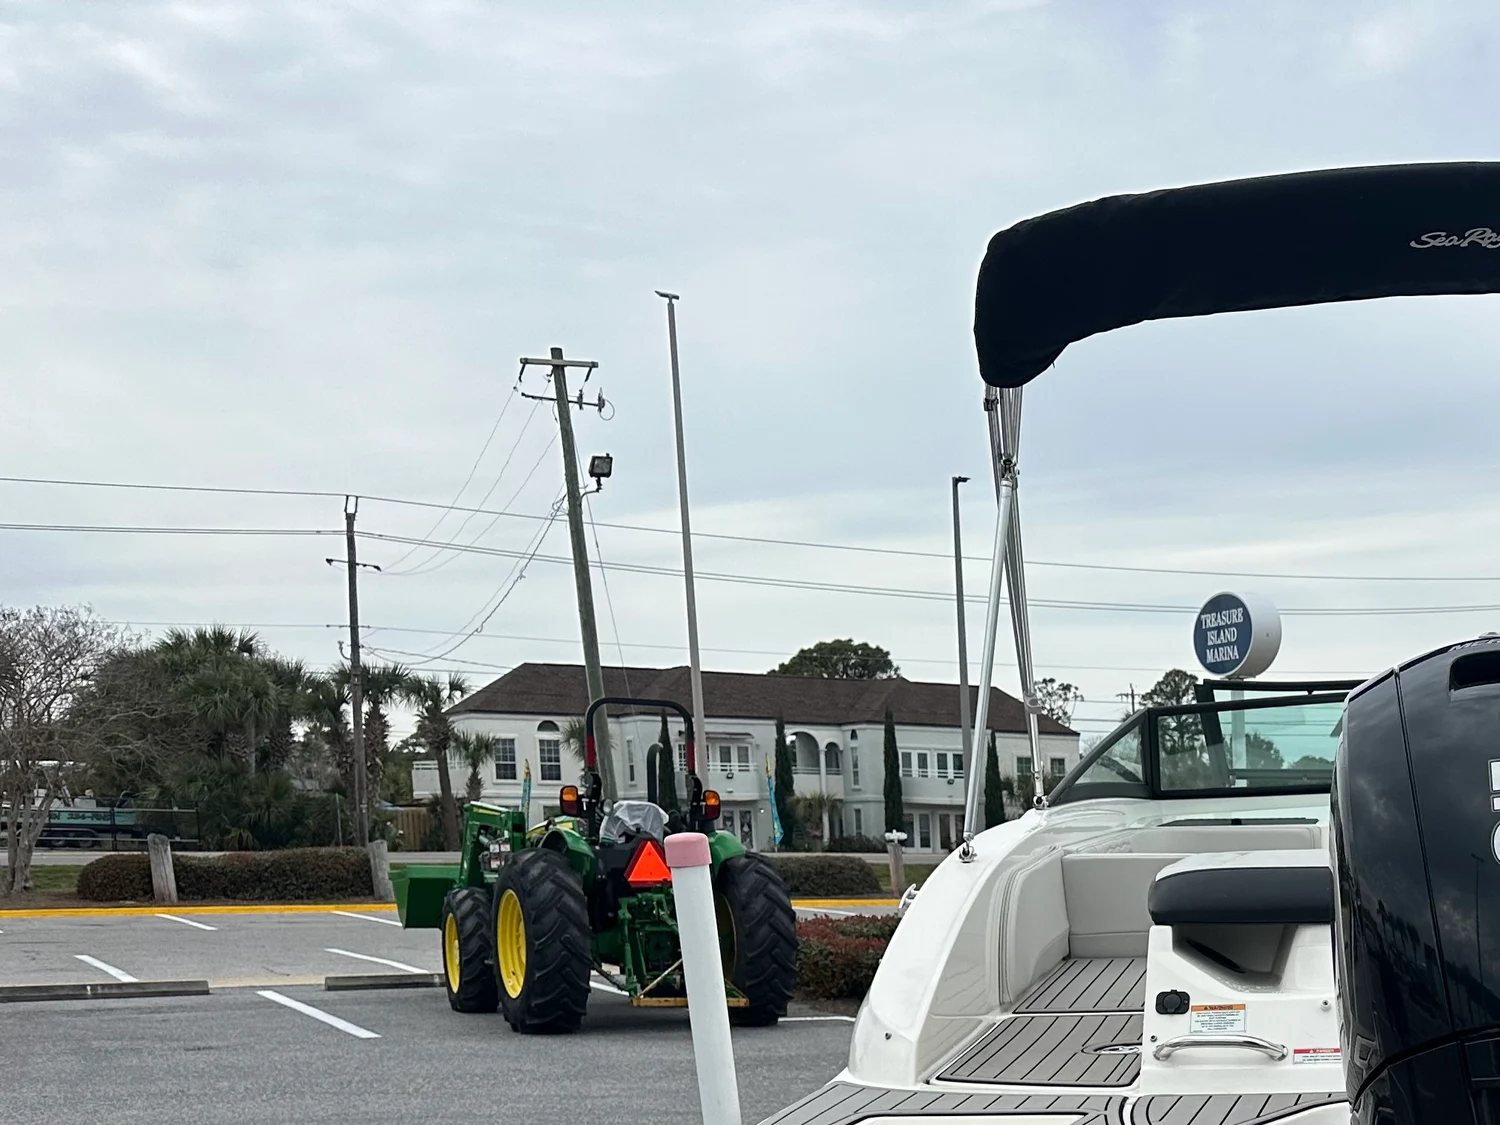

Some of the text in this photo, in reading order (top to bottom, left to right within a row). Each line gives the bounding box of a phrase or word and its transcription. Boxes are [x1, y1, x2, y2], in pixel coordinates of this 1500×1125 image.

[1409, 231, 1463, 249] Sea
[1200, 607, 1244, 630] TREASURE
[1207, 626, 1238, 646] ISLAND
[1206, 644, 1240, 664] MARINA
